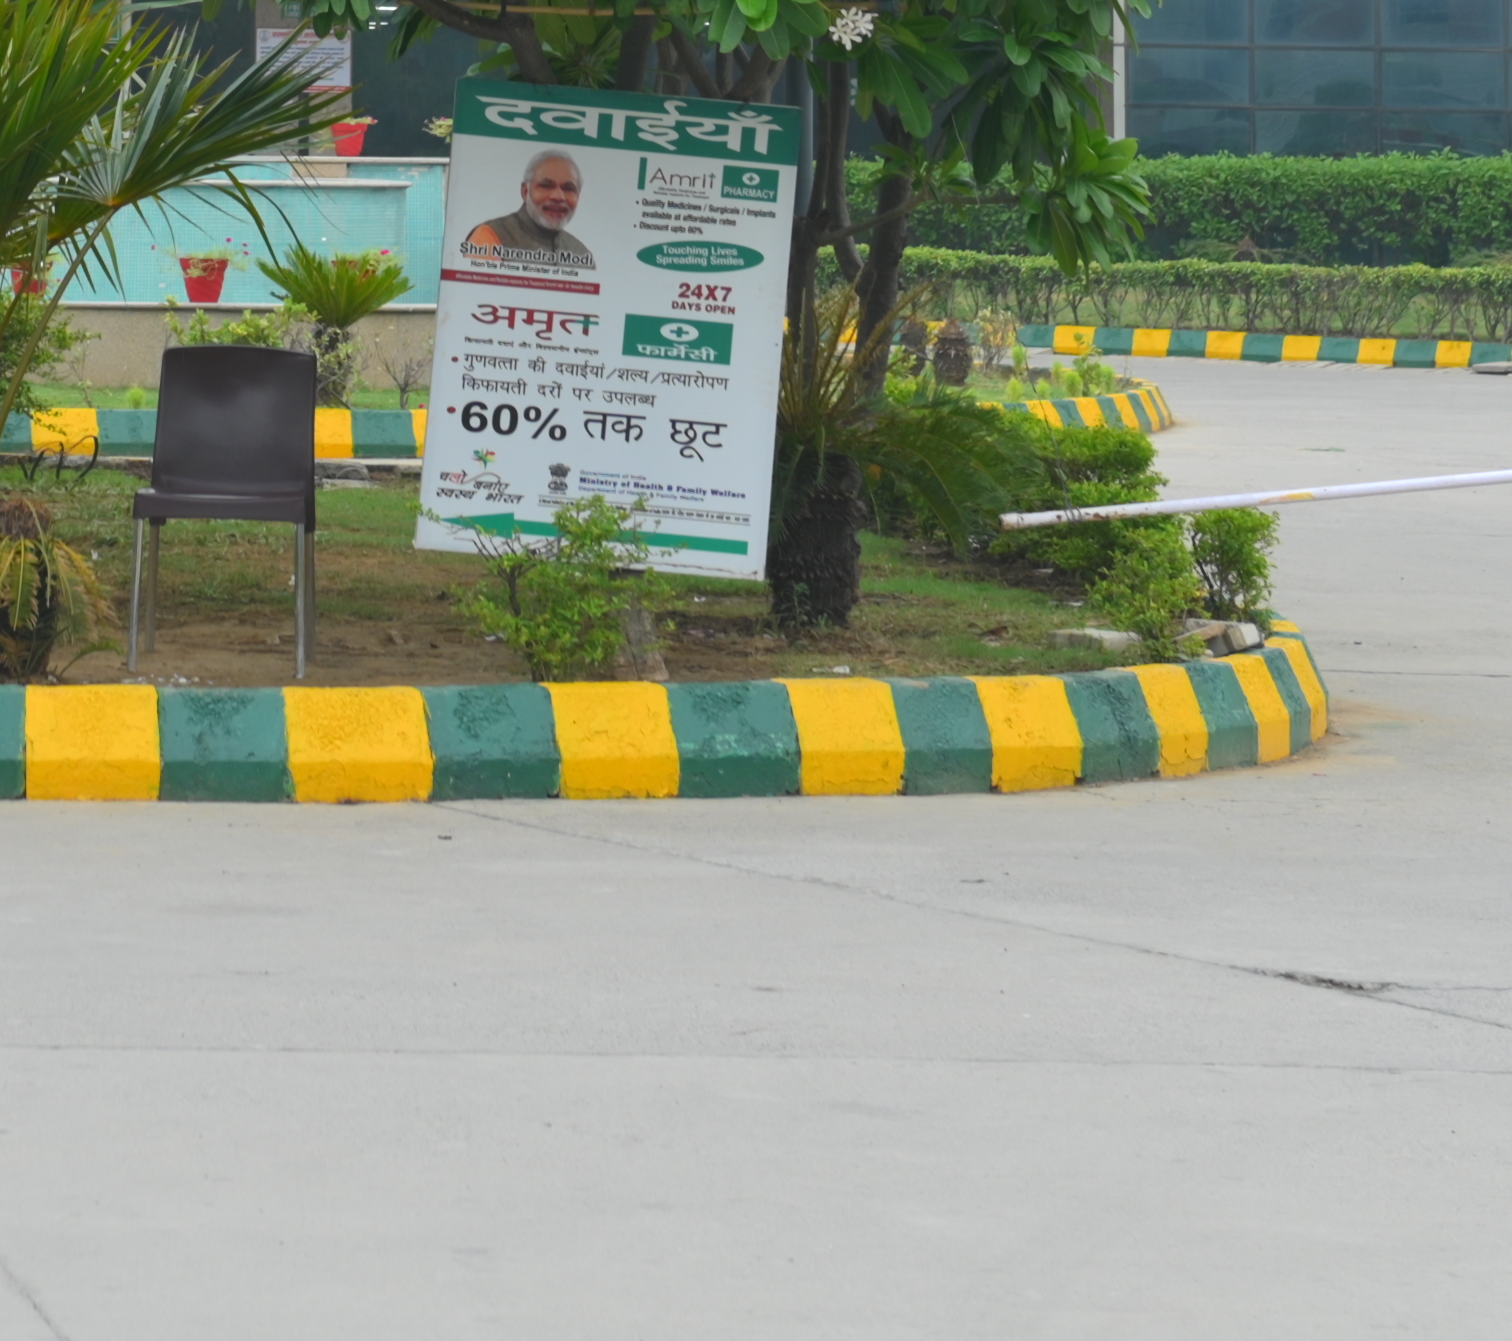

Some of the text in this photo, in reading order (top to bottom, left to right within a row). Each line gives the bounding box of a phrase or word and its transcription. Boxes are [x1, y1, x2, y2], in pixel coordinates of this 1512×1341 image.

[475, 95, 783, 155] दवाईयाँ
[649, 167, 716, 189] Amrit
[723, 185, 775, 199] PHARMACY
[642, 198, 665, 209] Quality
[667, 200, 701, 211] Medicines
[709, 204, 740, 215] Surgicals
[747, 208, 776, 219] Implants
[642, 210, 736, 226] available at affordable rates
[639, 221, 669, 232] Discount
[460, 242, 594, 265] Shri Narendra Modi
[656, 255, 744, 267] Spreading Smiles
[662, 245, 737, 257] Touching Lives
[500, 262, 519, 271] Prime
[522, 264, 550, 274] Minister
[552, 267, 559, 275] of
[561, 268, 578, 276] India
[678, 282, 732, 302] 24X7
[671, 300, 735, 315] DAYS OPEN
[471, 304, 600, 340] अमृत
[464, 353, 519, 372] गुणवत्ता
[528, 356, 546, 373] की
[462, 373, 657, 408] किफायती दरों पर उपलब्ध
[461, 400, 728, 463] 60% तक छूट
[440, 469, 468, 484] चलो
[485, 491, 524, 504] भारत
[579, 477, 617, 487] Ministry
[620, 480, 630, 488] of
[633, 482, 663, 491] Health
[676, 485, 707, 496] Family
[710, 488, 746, 499] Welfare
